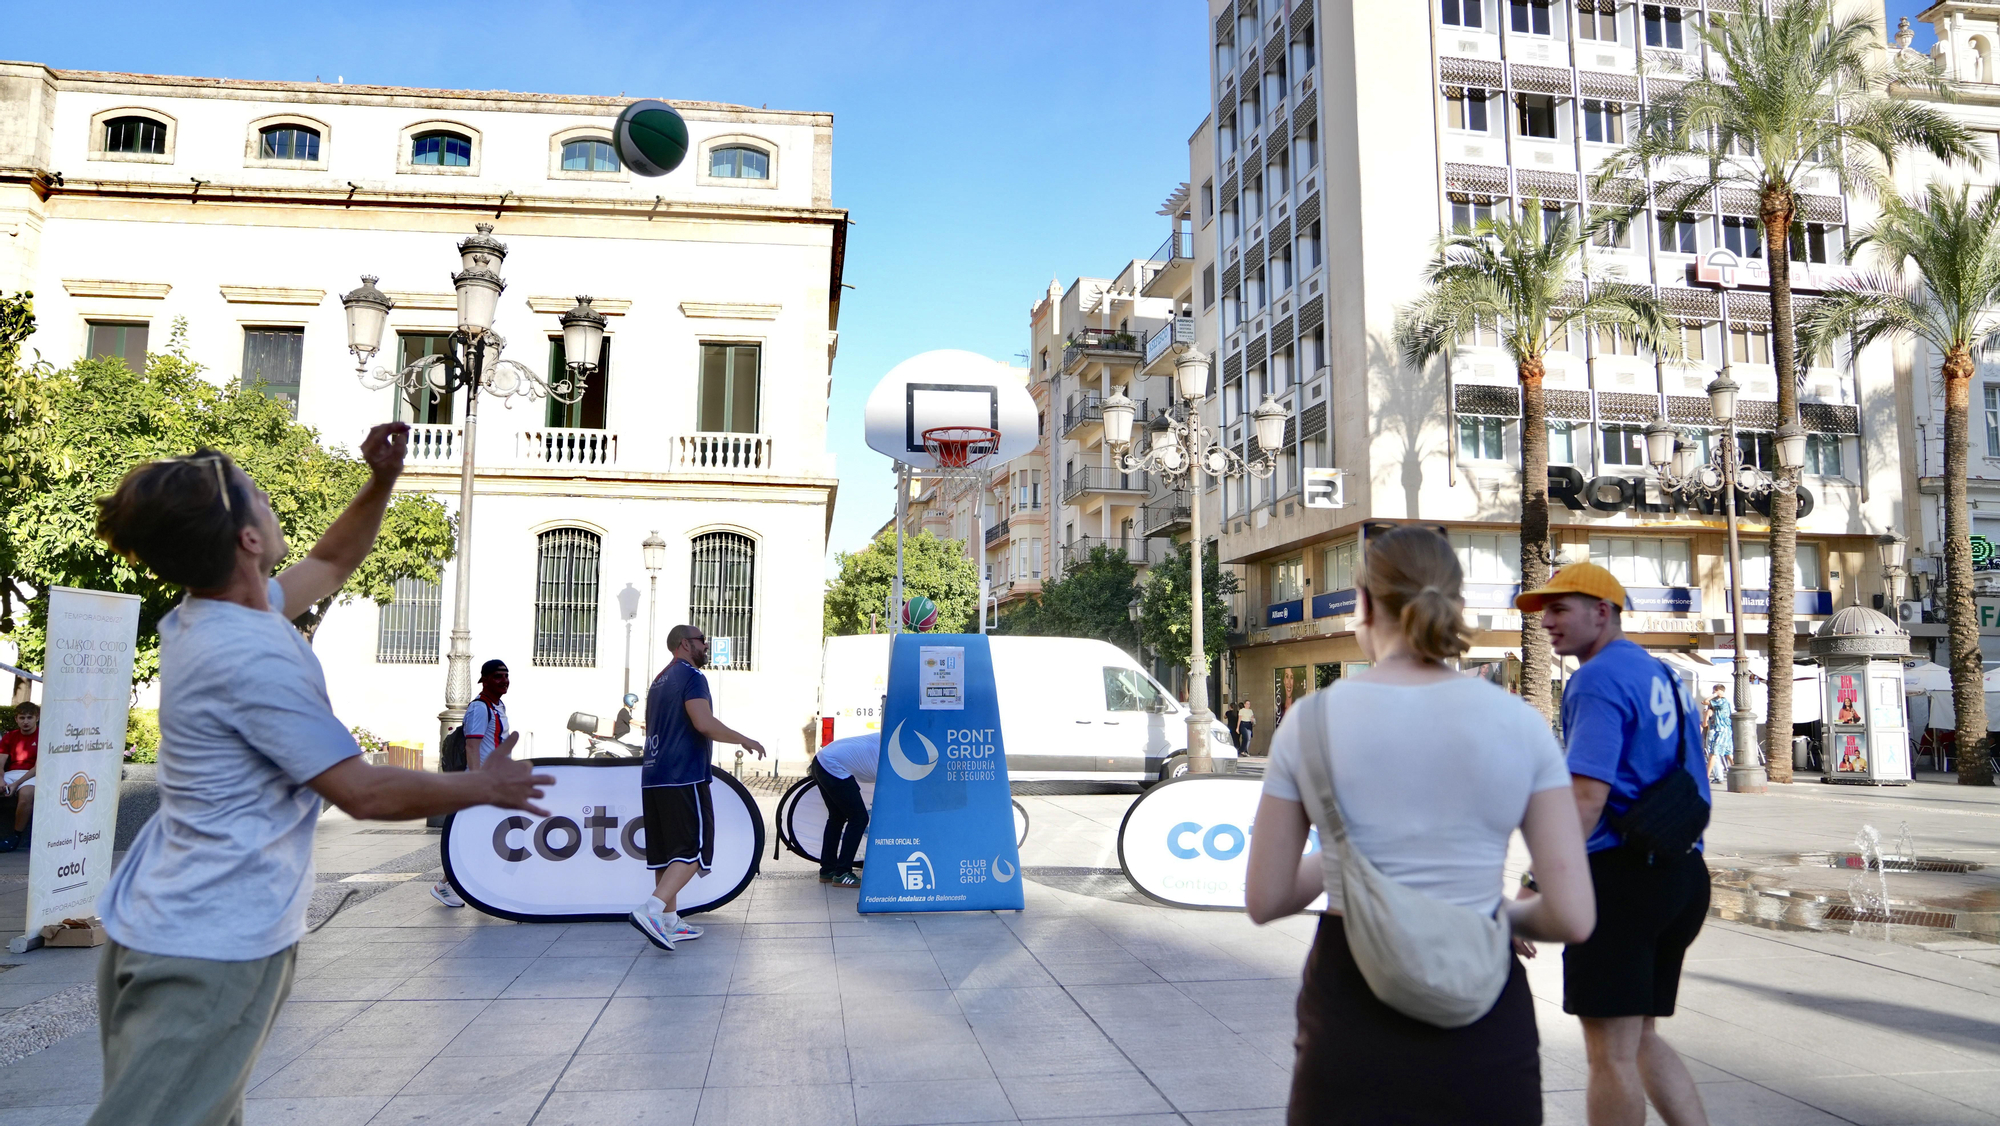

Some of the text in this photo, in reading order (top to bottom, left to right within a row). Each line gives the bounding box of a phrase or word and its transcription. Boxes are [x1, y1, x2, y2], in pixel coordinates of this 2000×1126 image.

[1308, 480, 1340, 504] R
[1740, 597, 1765, 606] llianz
[1272, 608, 1284, 618] Allianz
[1642, 616, 1704, 632] Aromas
[856, 708, 874, 717] 618
[947, 729, 995, 743] PONT
[48, 739, 113, 754] haciendo historia
[946, 745, 995, 759] GRUP
[946, 760, 996, 771] CORREDURÍA
[947, 771, 996, 781] DE SEGUROS
[874, 838, 895, 846] PARTNER
[959, 859, 987, 868] CLUB
[959, 867, 987, 876] PONT
[959, 875, 987, 884] GRUP
[865, 895, 897, 903] Federación
